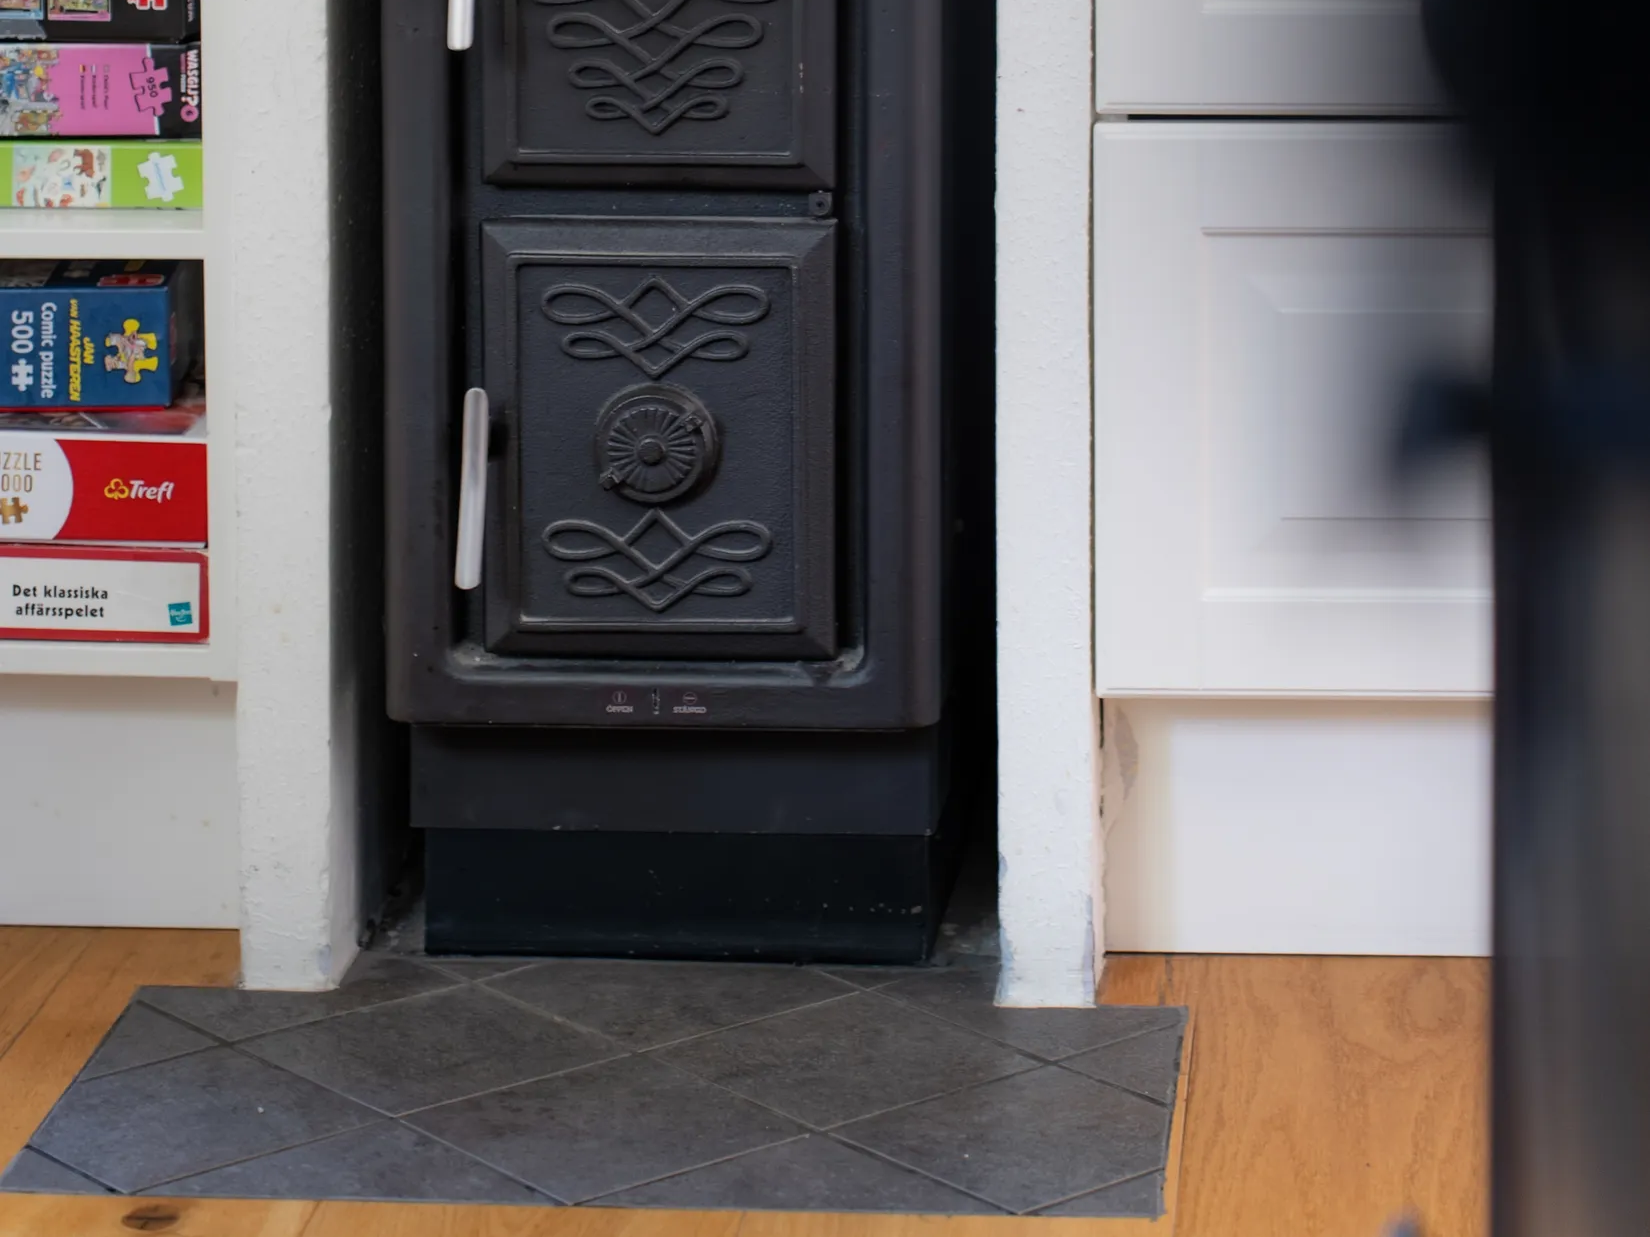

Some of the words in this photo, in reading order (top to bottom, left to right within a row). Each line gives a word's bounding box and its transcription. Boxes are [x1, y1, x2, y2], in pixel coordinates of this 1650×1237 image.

[145, 75, 159, 99] 950
[181, 49, 199, 106] WASGIJ?
[11, 310, 34, 354] 500
[40, 302, 57, 347] Comic
[69, 319, 81, 402] HAASTEREN
[83, 337, 95, 364] JAN
[40, 351, 57, 399] puzzle
[0, 452, 42, 471] ZZLE
[129, 479, 175, 504] Trefl
[12, 584, 38, 598] Det
[43, 585, 109, 600] klassiska
[15, 602, 105, 619] affärsspelet
